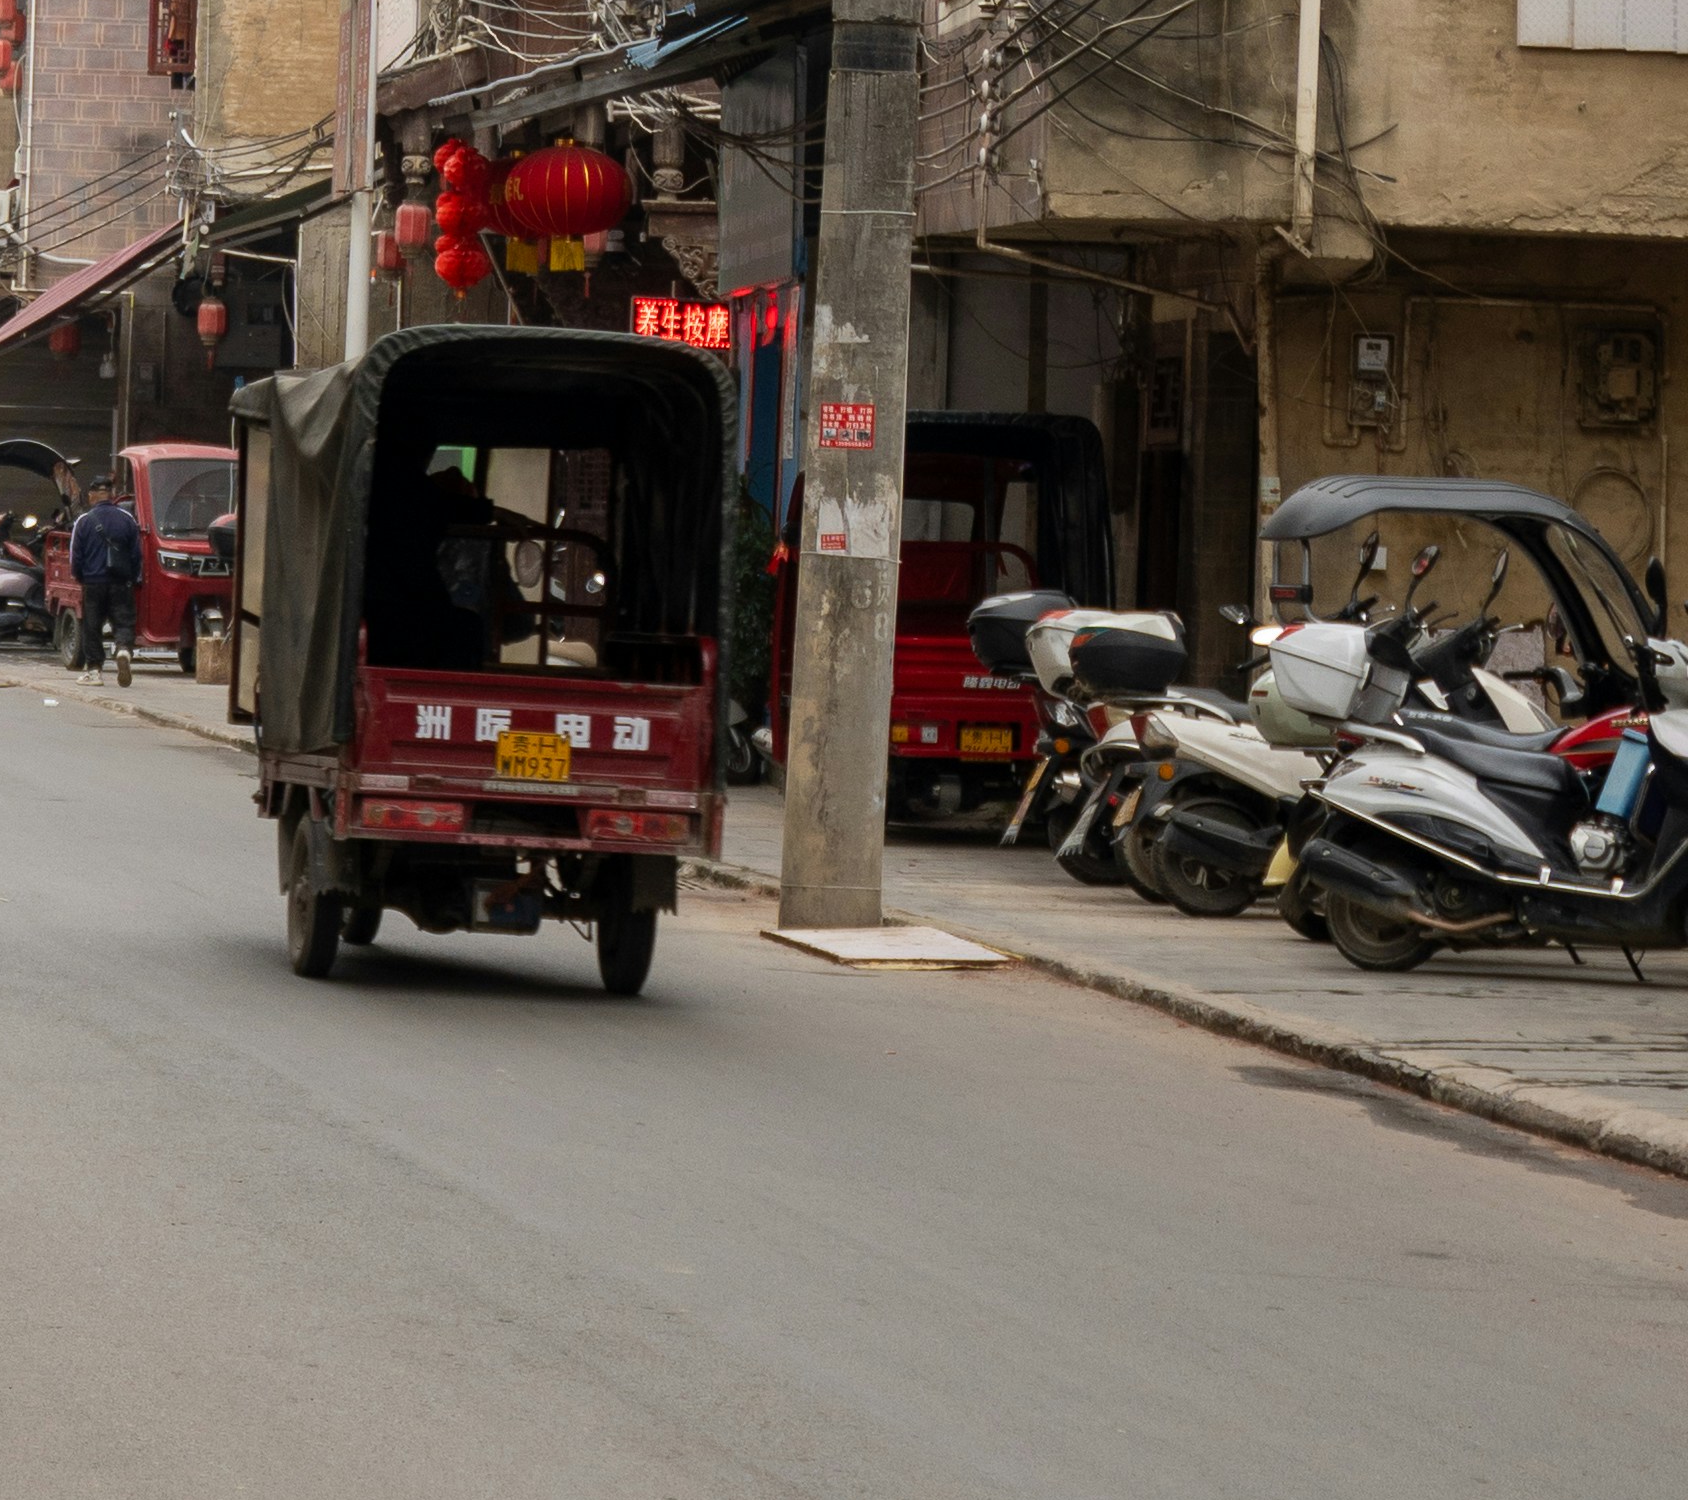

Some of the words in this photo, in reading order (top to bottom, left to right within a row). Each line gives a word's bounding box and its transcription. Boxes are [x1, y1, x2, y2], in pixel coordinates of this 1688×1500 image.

[636, 304, 729, 344] 养生按摩
[500, 755, 567, 779] WM937
